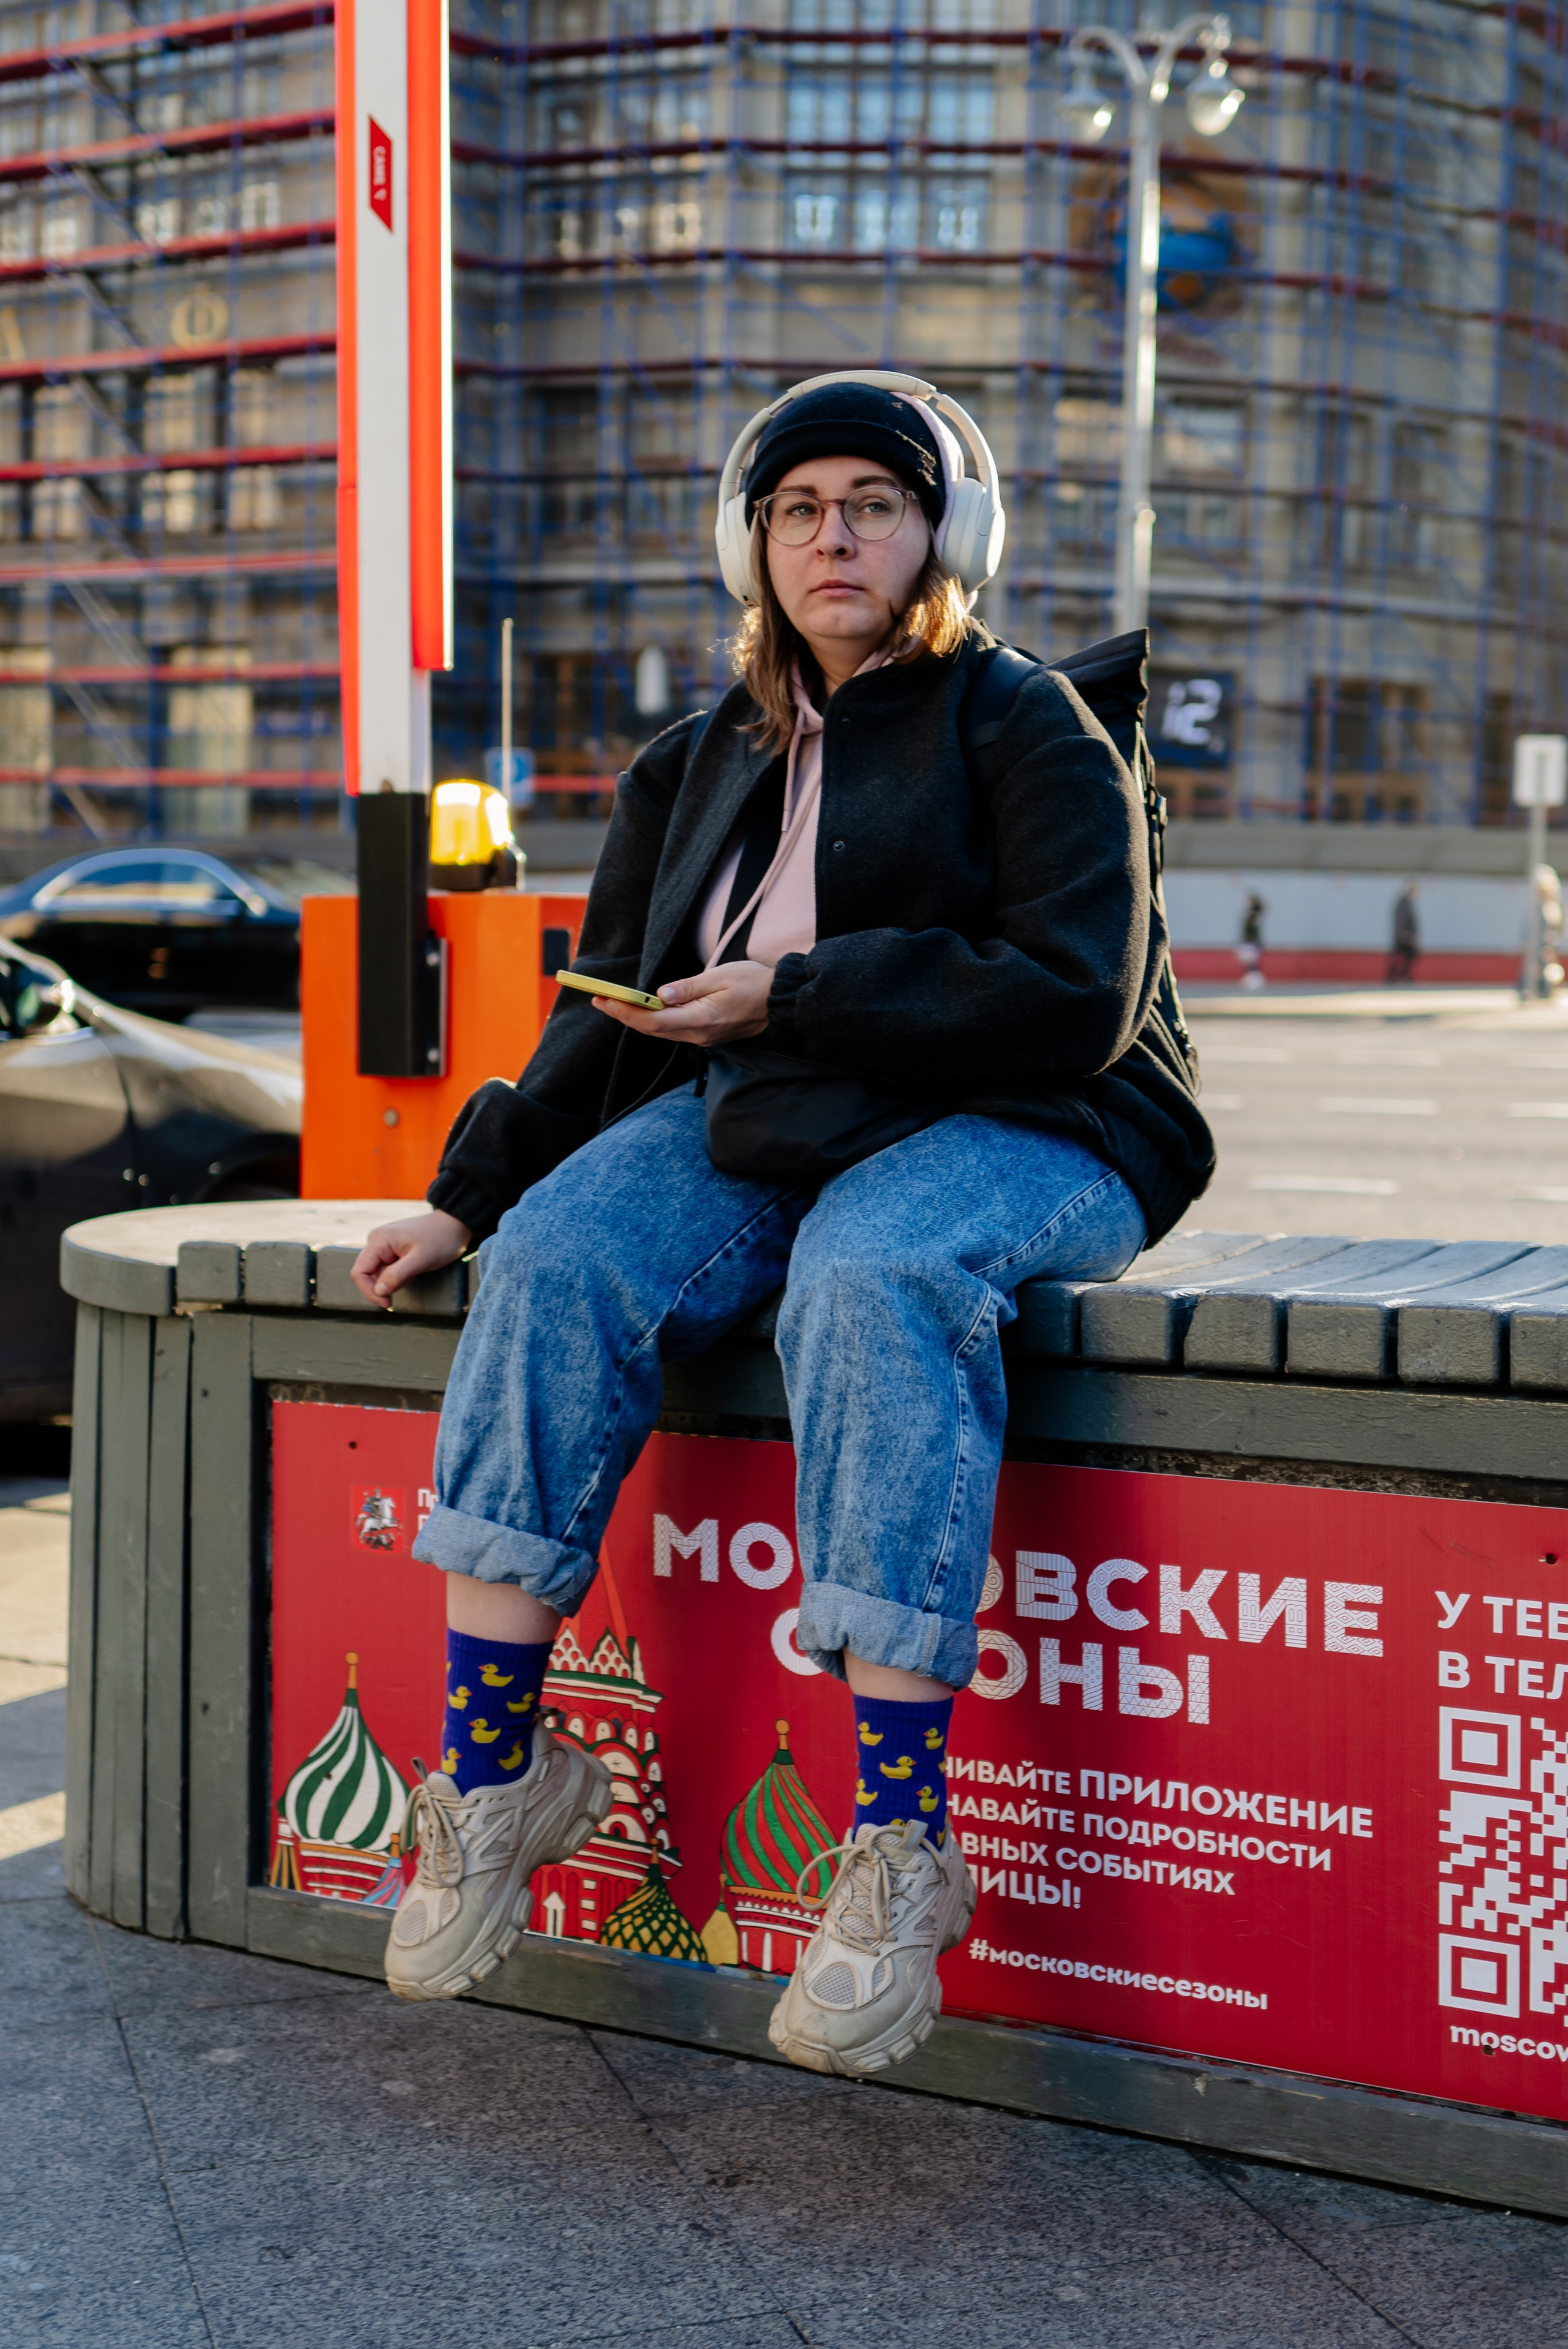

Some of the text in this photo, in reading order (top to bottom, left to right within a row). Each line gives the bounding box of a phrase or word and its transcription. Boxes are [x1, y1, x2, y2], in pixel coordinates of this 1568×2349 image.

[654, 1514, 1384, 1657] МОВСКИЕ
[1434, 1591, 1471, 1629] У
[771, 1608, 1210, 1725] СОНЫ
[1438, 1650, 1471, 1689] В
[945, 1756, 1373, 1838] ИВАЙТЕ ПРИЛОЖЕНИЕ
[946, 1793, 1331, 1871] НАВАЙТЕ ПОДРОБНОСТИ
[959, 1831, 1235, 1896] ВНЫХ СОБЫТИЯХ
[967, 1864, 1081, 1908] ИЦЫ!
[969, 1937, 1268, 2010] #московскиесезоны
